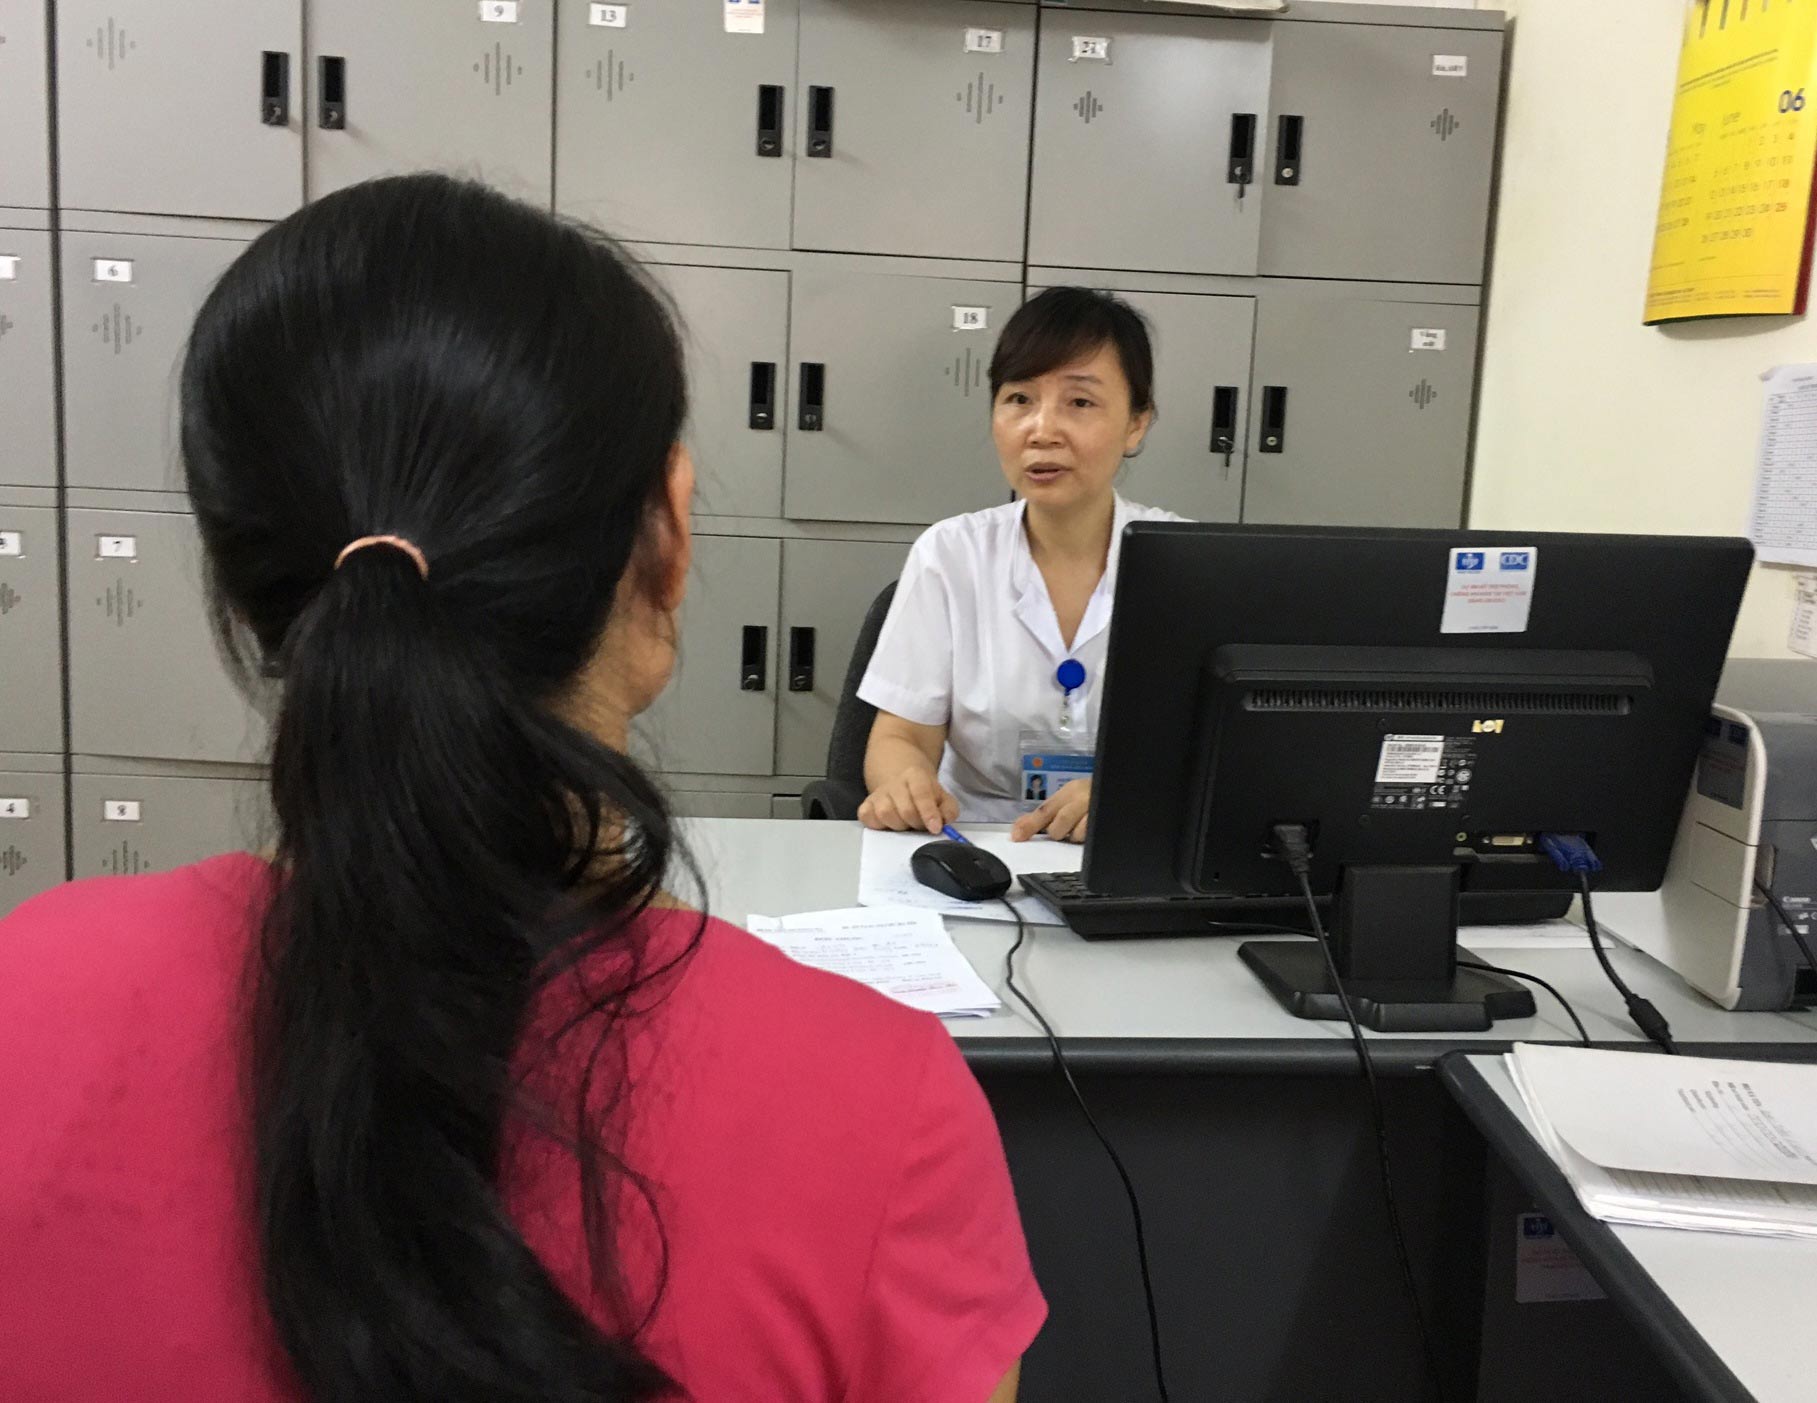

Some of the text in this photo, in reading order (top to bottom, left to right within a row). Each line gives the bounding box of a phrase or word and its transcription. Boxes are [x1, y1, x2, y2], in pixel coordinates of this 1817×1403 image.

[493, 4, 504, 17] 9
[600, 9, 617, 22] 13
[976, 34, 993, 48] 17
[1778, 87, 1806, 113] 06
[107, 264, 119, 277] 6
[963, 312, 979, 325] 18
[112, 540, 123, 553] 7
[116, 804, 128, 816] 8
